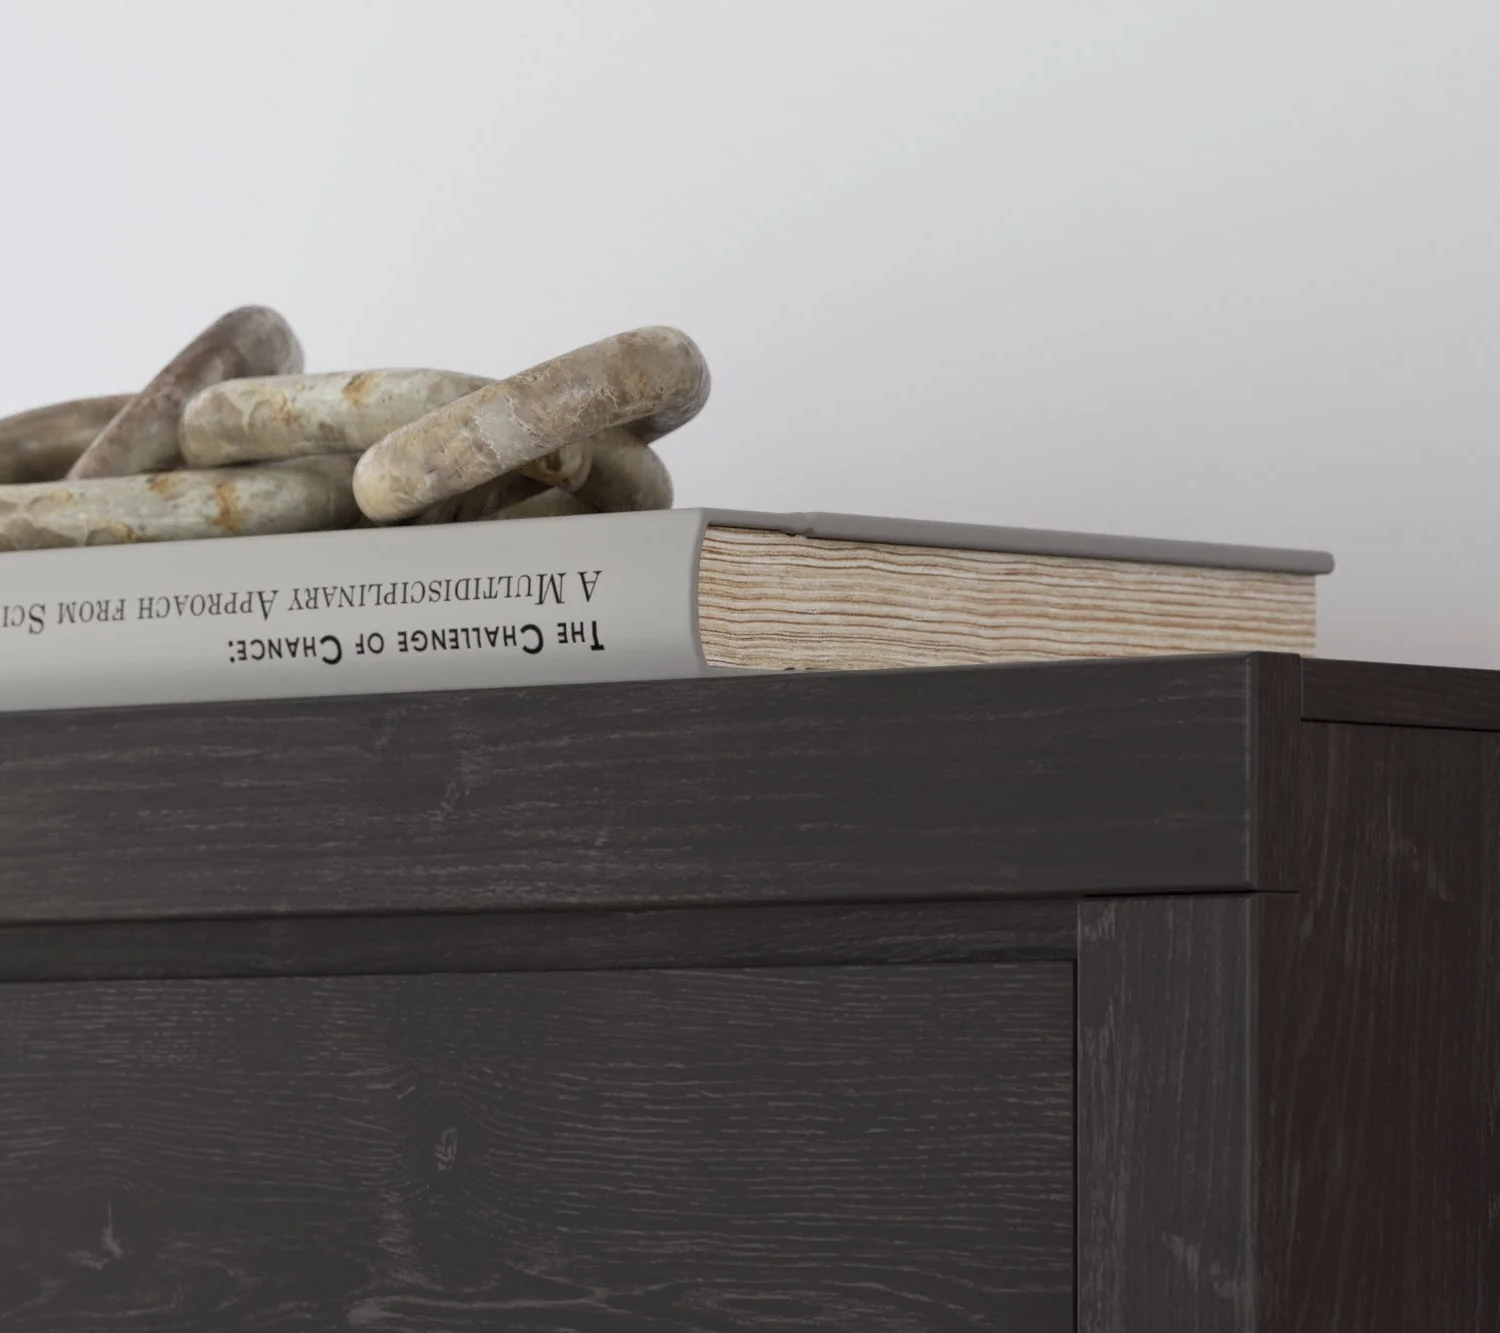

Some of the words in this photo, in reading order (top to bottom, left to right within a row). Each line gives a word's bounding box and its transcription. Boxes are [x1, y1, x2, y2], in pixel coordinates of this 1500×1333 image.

[287, 571, 568, 612] MULTIDISCIPLINARY
[576, 569, 603, 604] A
[56, 598, 127, 625] FROM
[136, 588, 280, 622] APPROACH
[227, 633, 344, 666] CHANCE:
[354, 631, 385, 656] OF
[396, 622, 545, 656] CHALLENGE
[555, 619, 606, 652] THE
